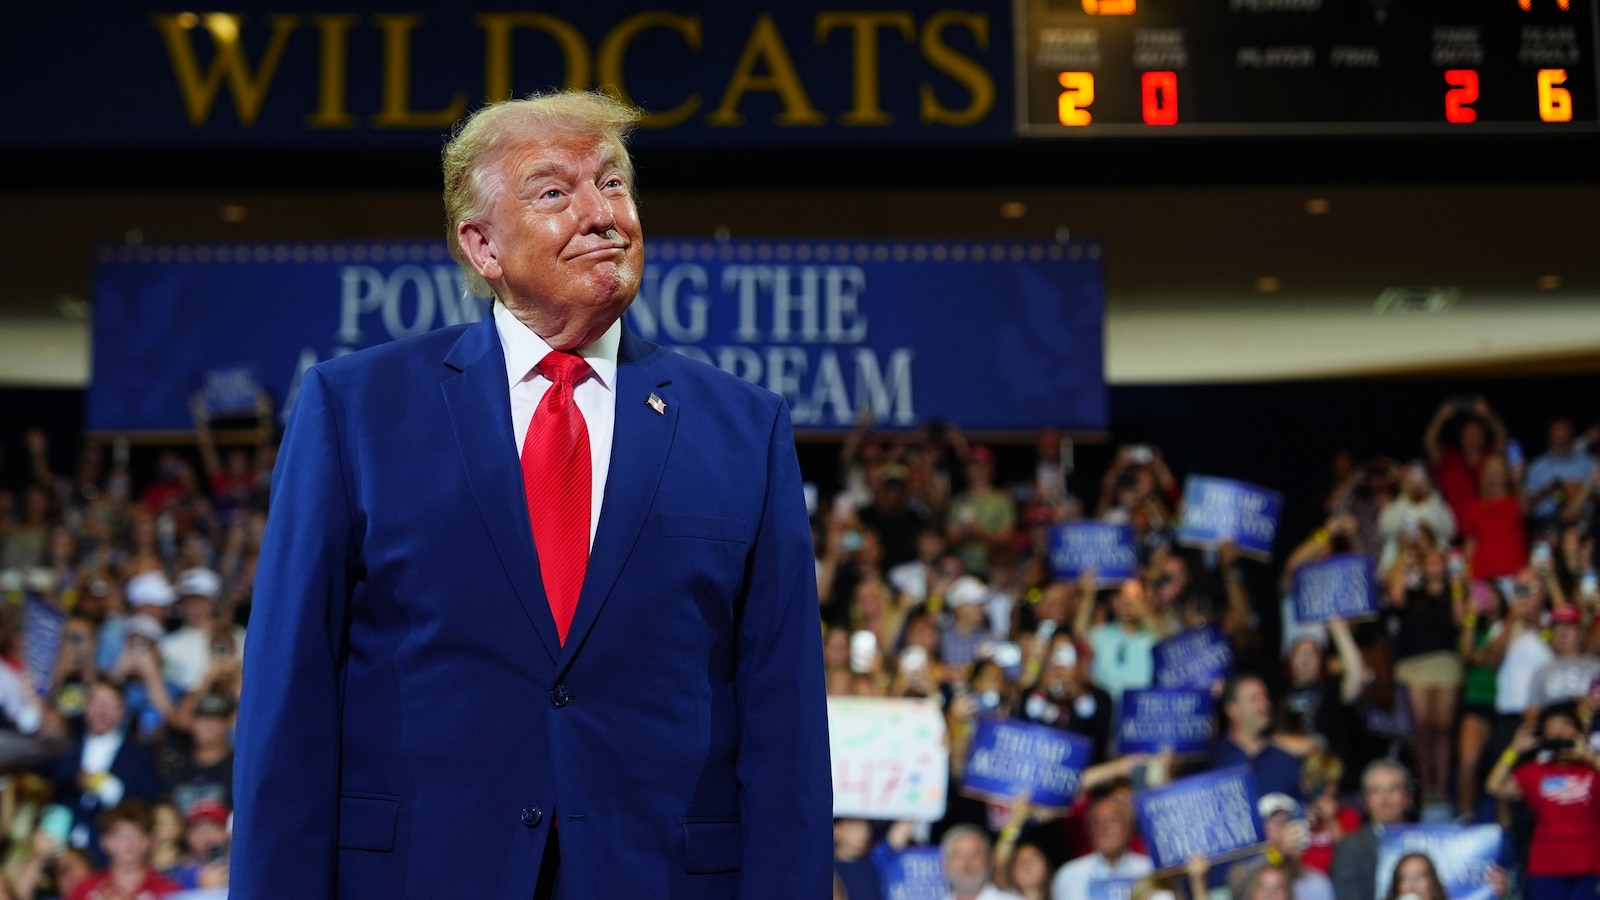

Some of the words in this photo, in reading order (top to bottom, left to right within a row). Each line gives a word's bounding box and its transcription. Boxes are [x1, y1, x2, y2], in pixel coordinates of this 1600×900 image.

[160, 11, 996, 129] WILDCATS
[1444, 70, 1479, 123] 2
[1536, 69, 1573, 122] 6
[1057, 71, 1095, 126] 2
[1141, 71, 1178, 125] 0
[338, 264, 708, 342] POWNG
[725, 265, 867, 343] THE
[994, 725, 1072, 766] TRUMP
